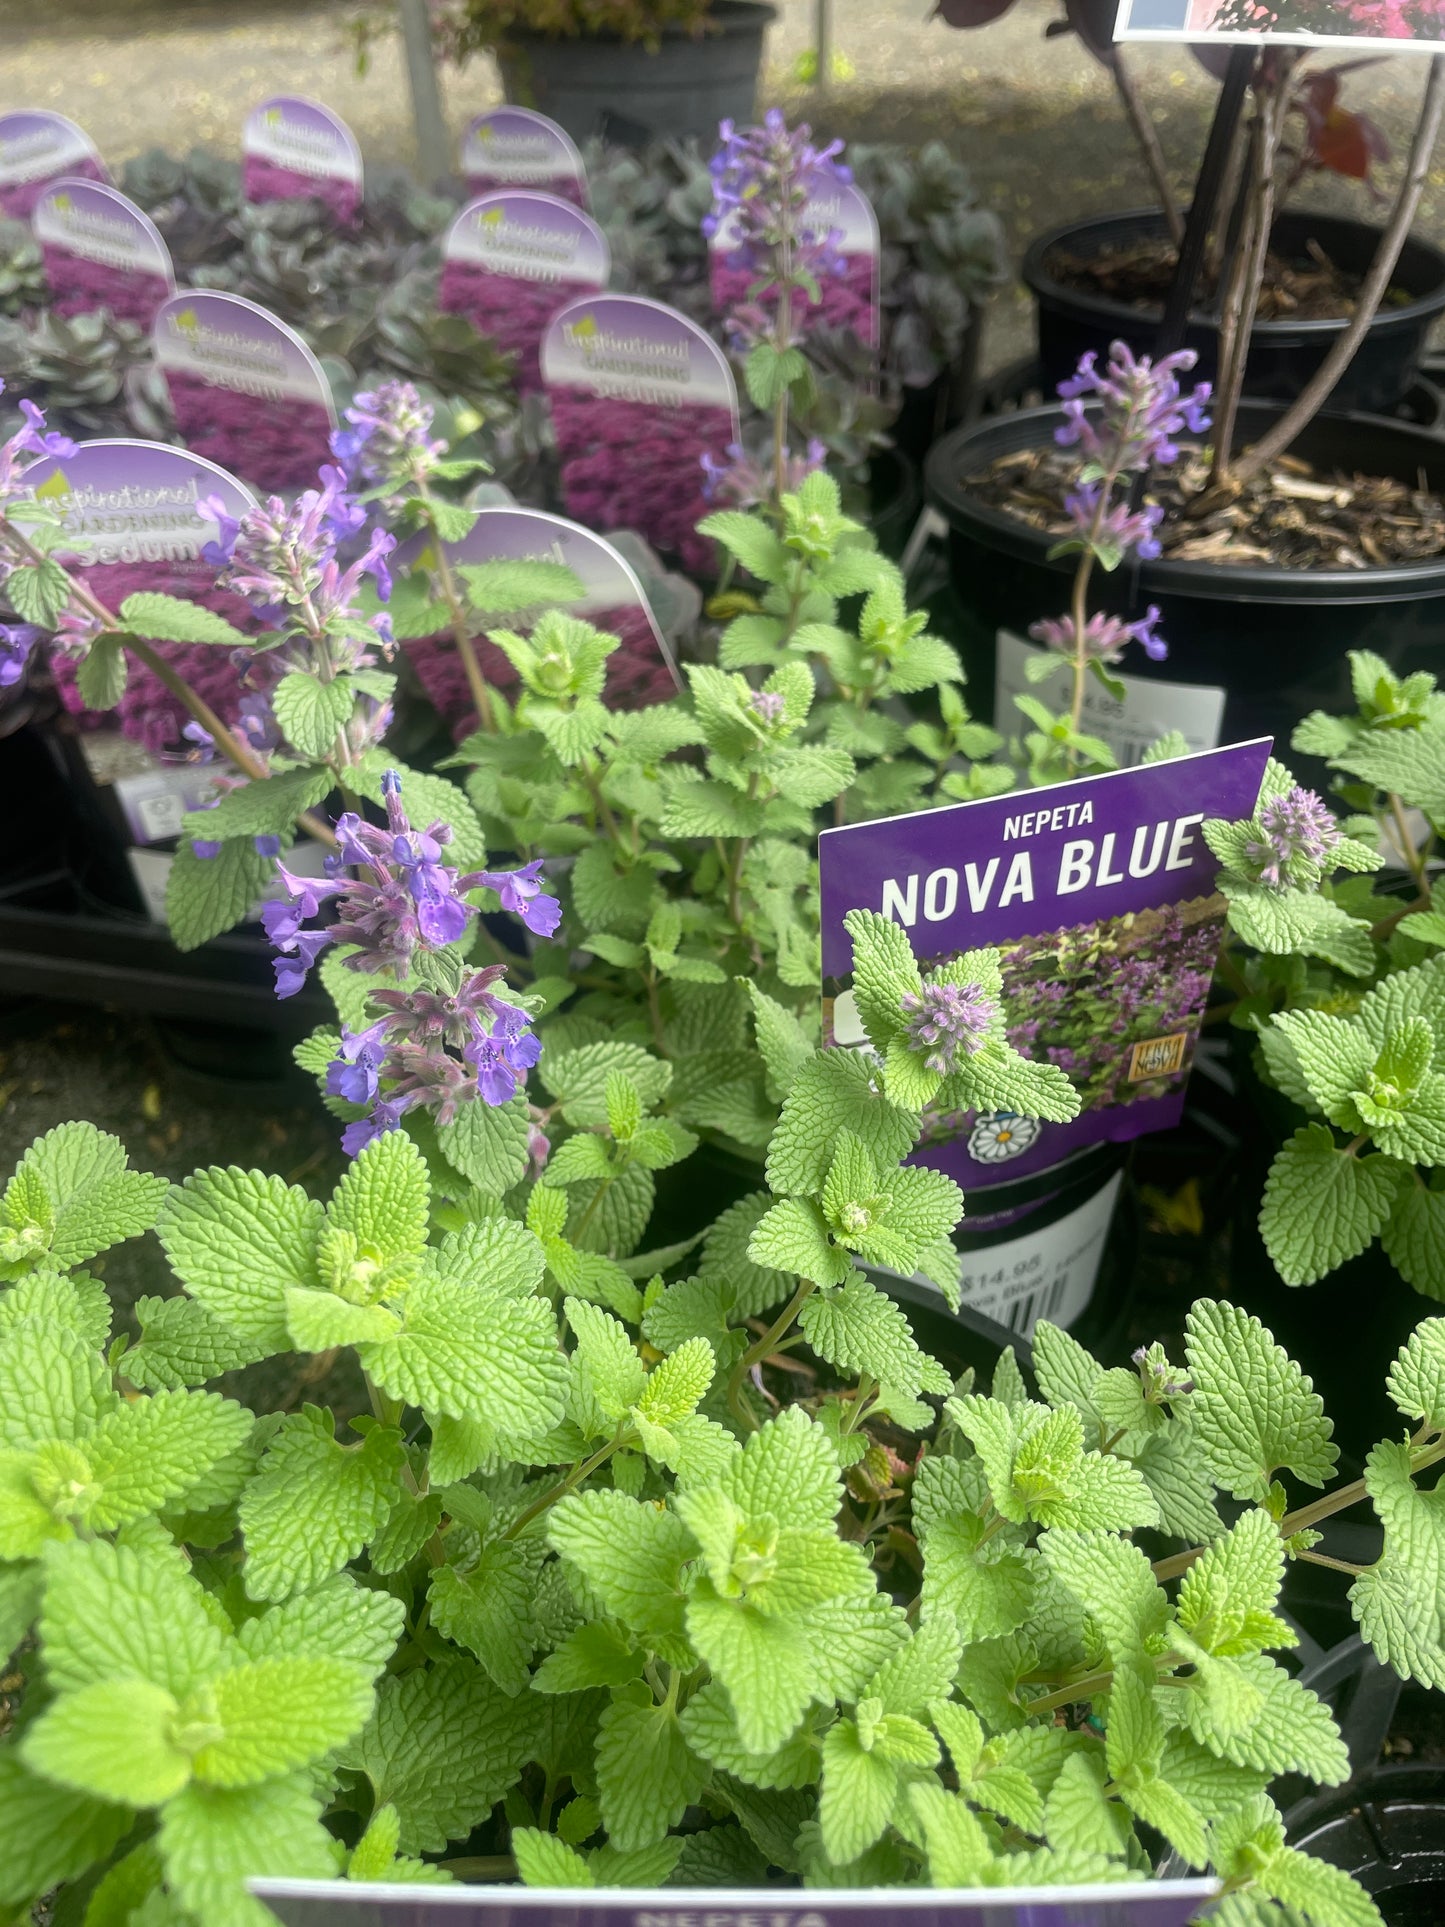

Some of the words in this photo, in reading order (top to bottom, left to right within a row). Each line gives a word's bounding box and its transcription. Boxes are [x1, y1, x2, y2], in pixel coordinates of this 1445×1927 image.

[1003, 800, 1094, 841] NEPETA
[881, 850, 1035, 928] NOVA
[1056, 812, 1205, 896] BLUE
[960, 1253, 1043, 1293] $14.95
